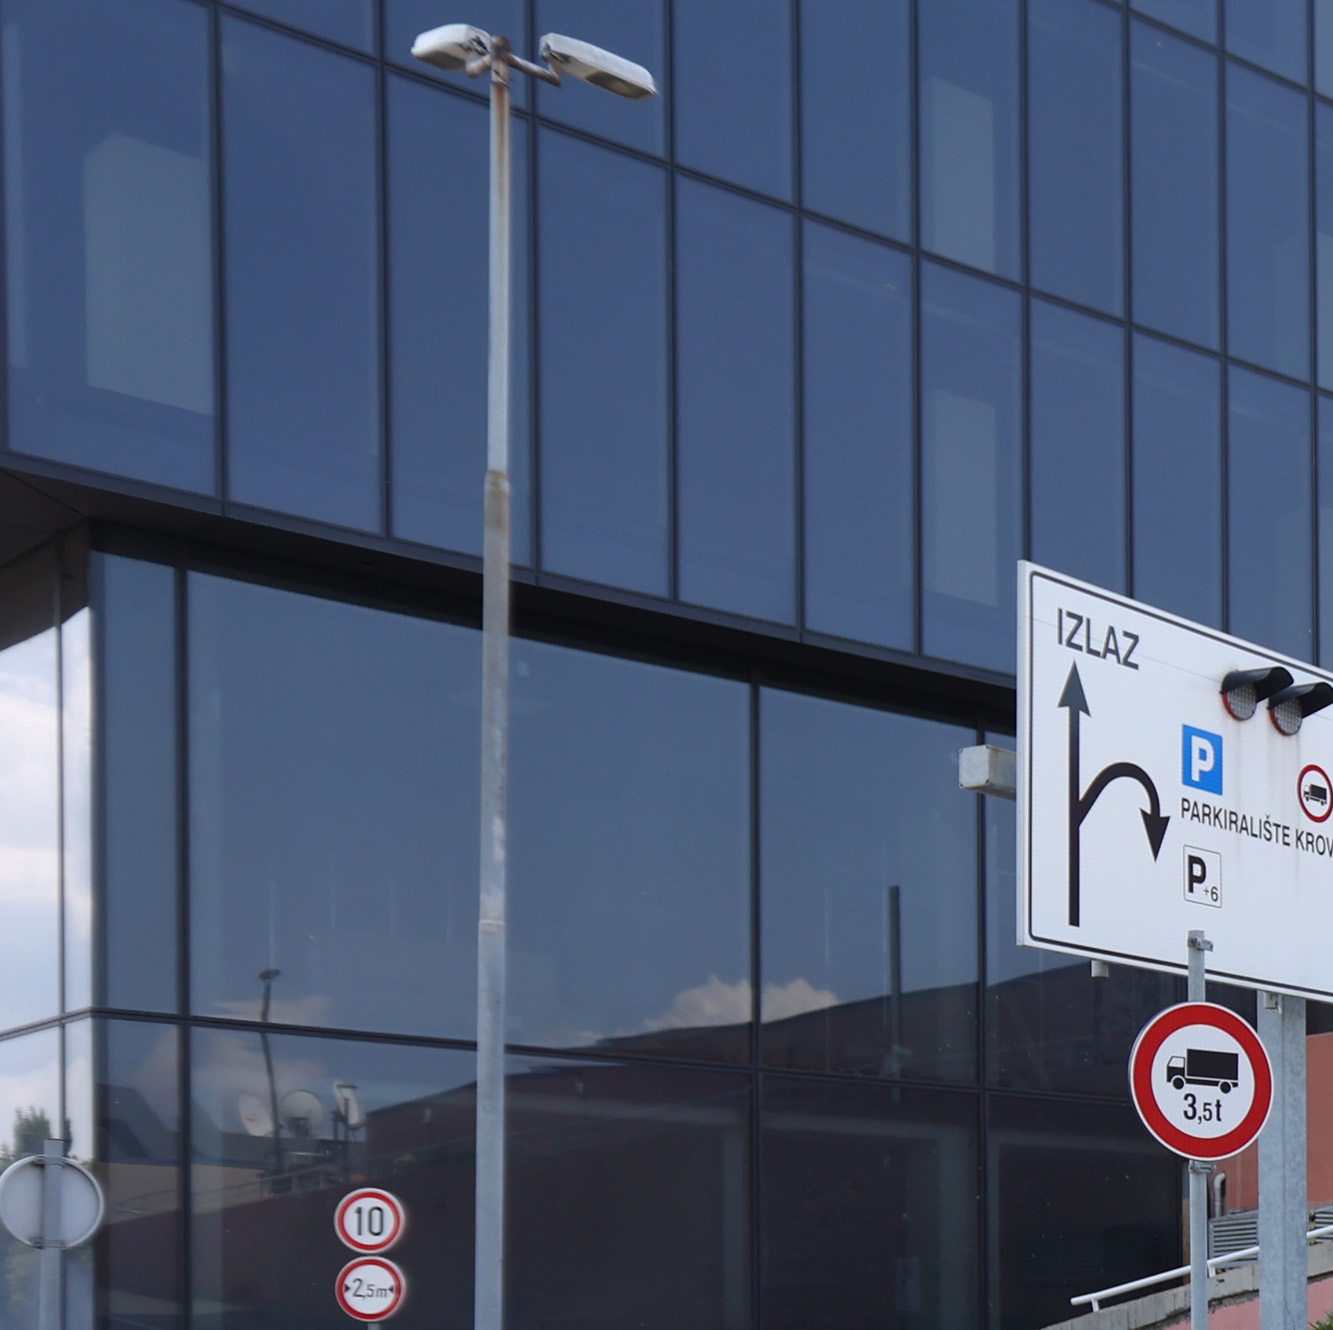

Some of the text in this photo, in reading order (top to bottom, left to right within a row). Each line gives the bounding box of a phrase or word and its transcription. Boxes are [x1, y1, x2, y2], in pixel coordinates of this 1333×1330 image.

[1057, 607, 1139, 671] IZLAZ
[1191, 735, 1215, 783] P
[1181, 797, 1290, 847] PARKIRALIŠTE
[354, 1206, 384, 1236] 10
[352, 1278, 387, 1299] 2,5m
